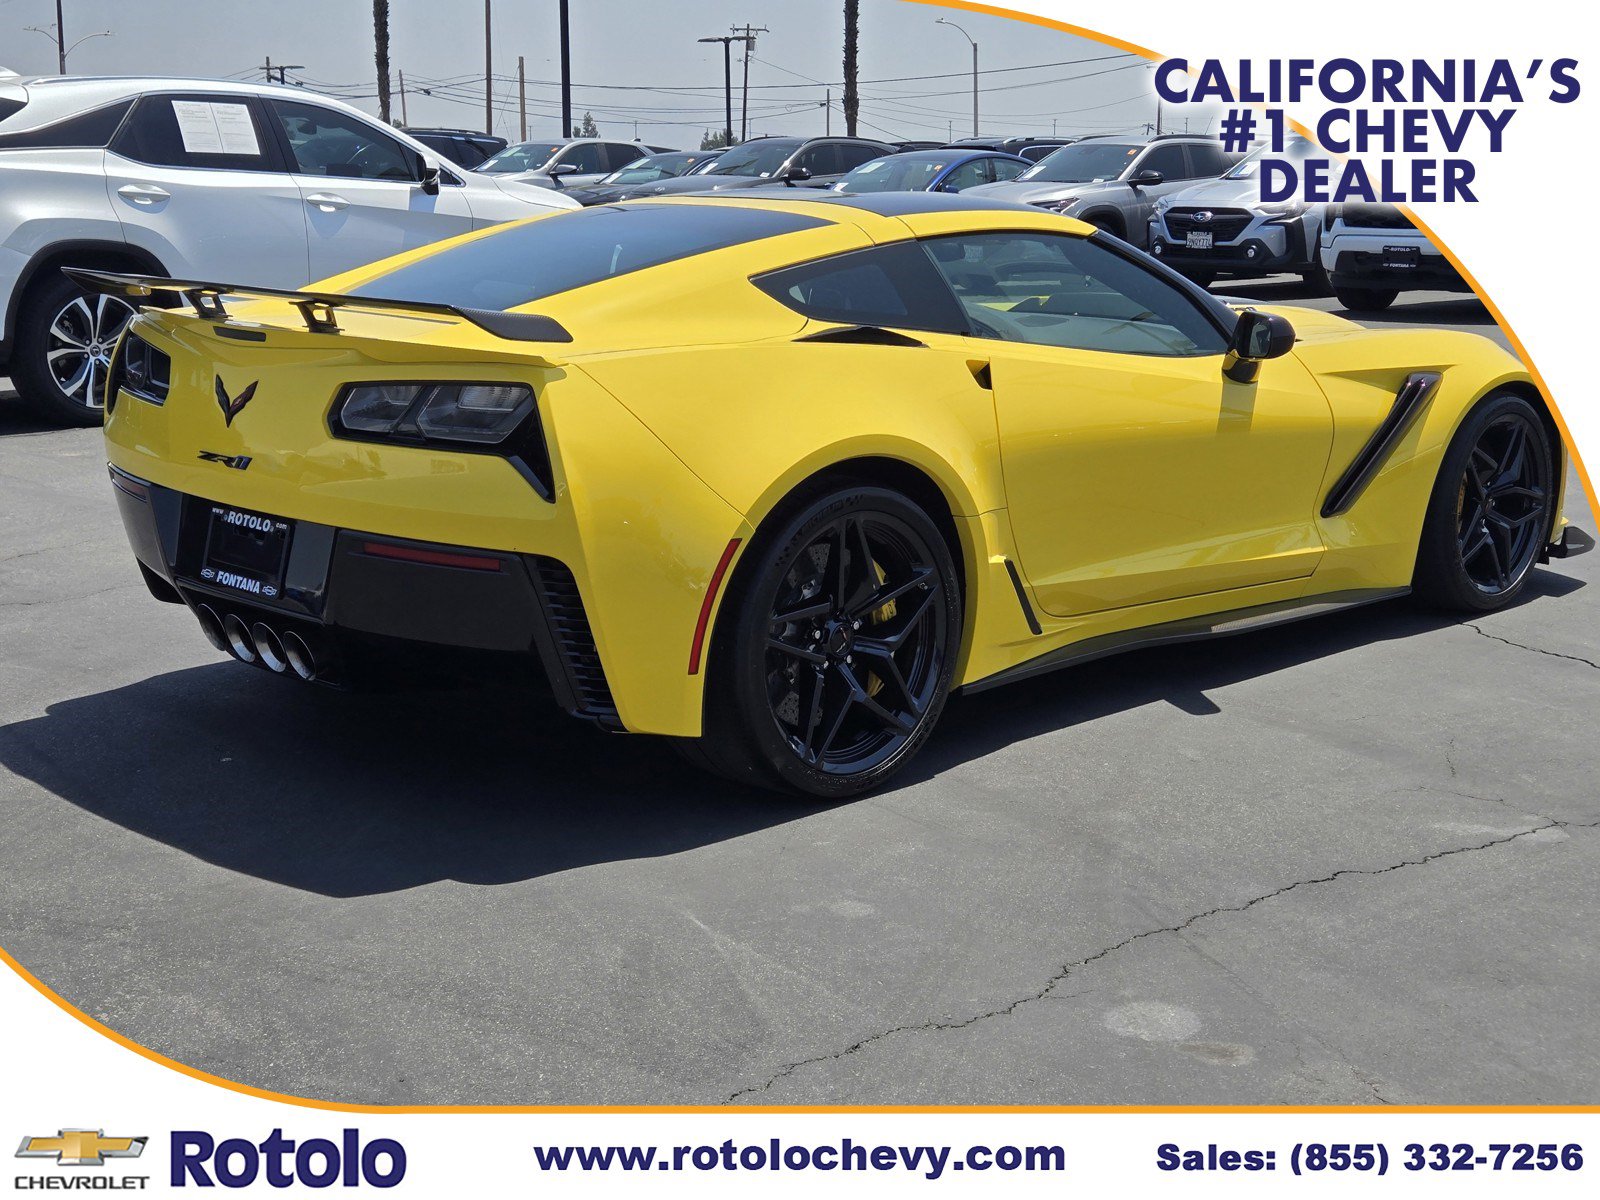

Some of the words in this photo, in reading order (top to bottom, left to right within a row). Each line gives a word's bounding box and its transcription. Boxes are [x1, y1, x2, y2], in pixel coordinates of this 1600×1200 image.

[197, 450, 253, 470] ZR1
[227, 511, 271, 532] ROTOLO
[216, 571, 260, 594] FONTANA
